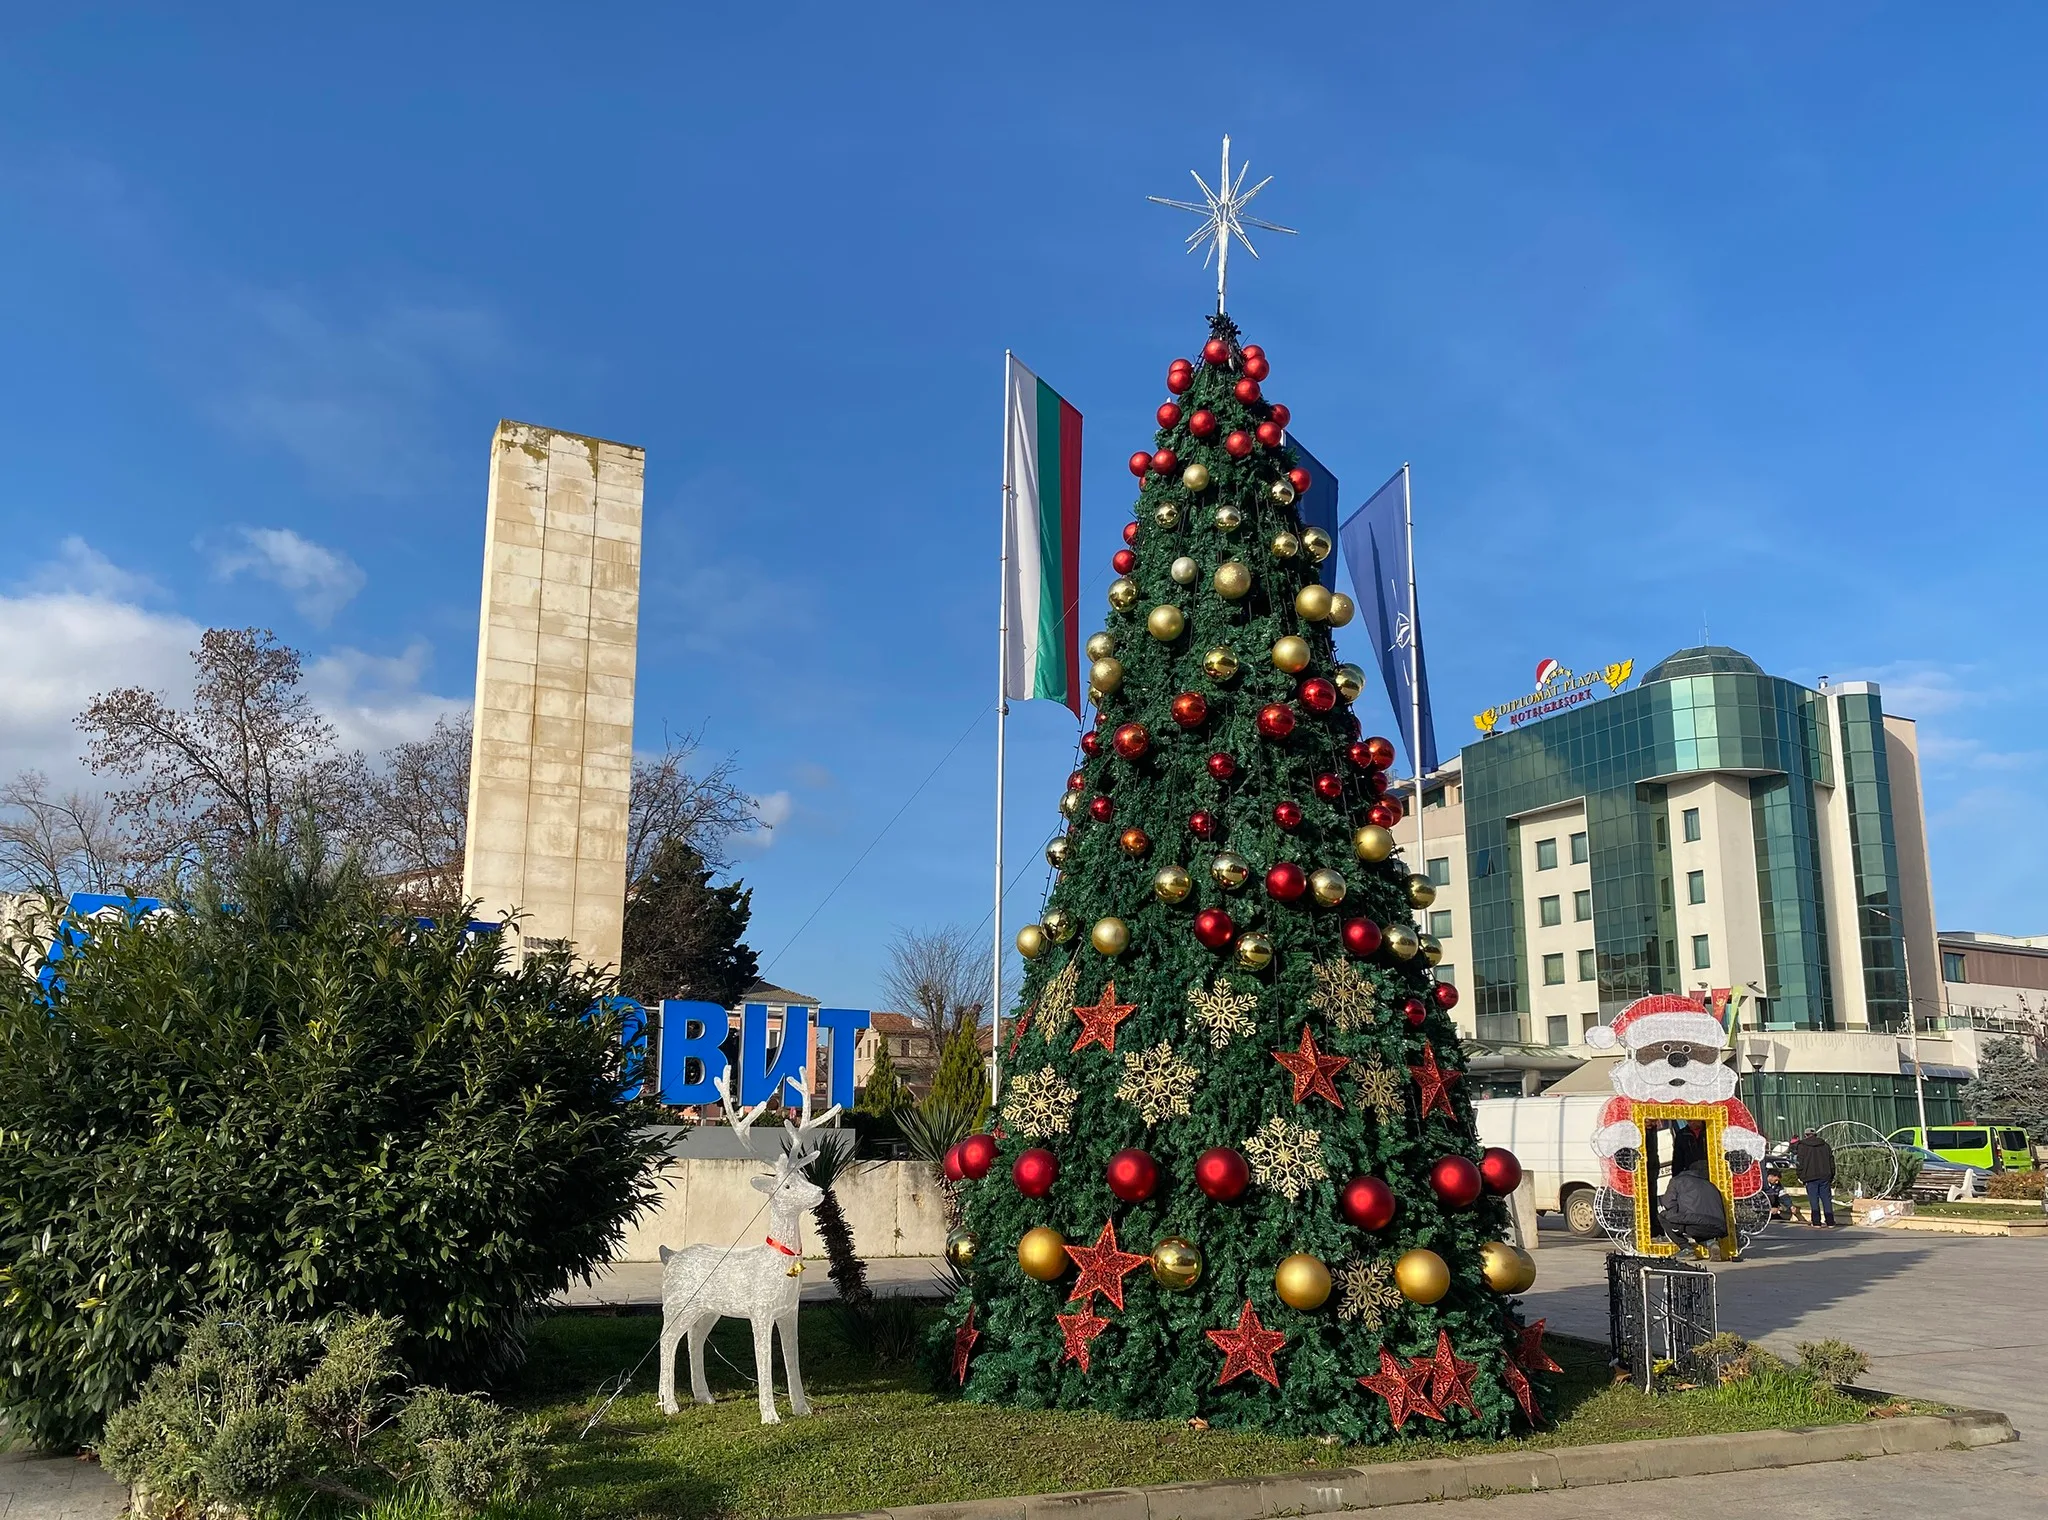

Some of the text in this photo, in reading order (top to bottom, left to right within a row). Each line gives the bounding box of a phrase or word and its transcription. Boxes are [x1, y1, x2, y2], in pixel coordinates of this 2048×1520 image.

[1499, 670, 1602, 716] DIPLOMAT PLAZA
[576, 995, 871, 1109] ОВИТ
